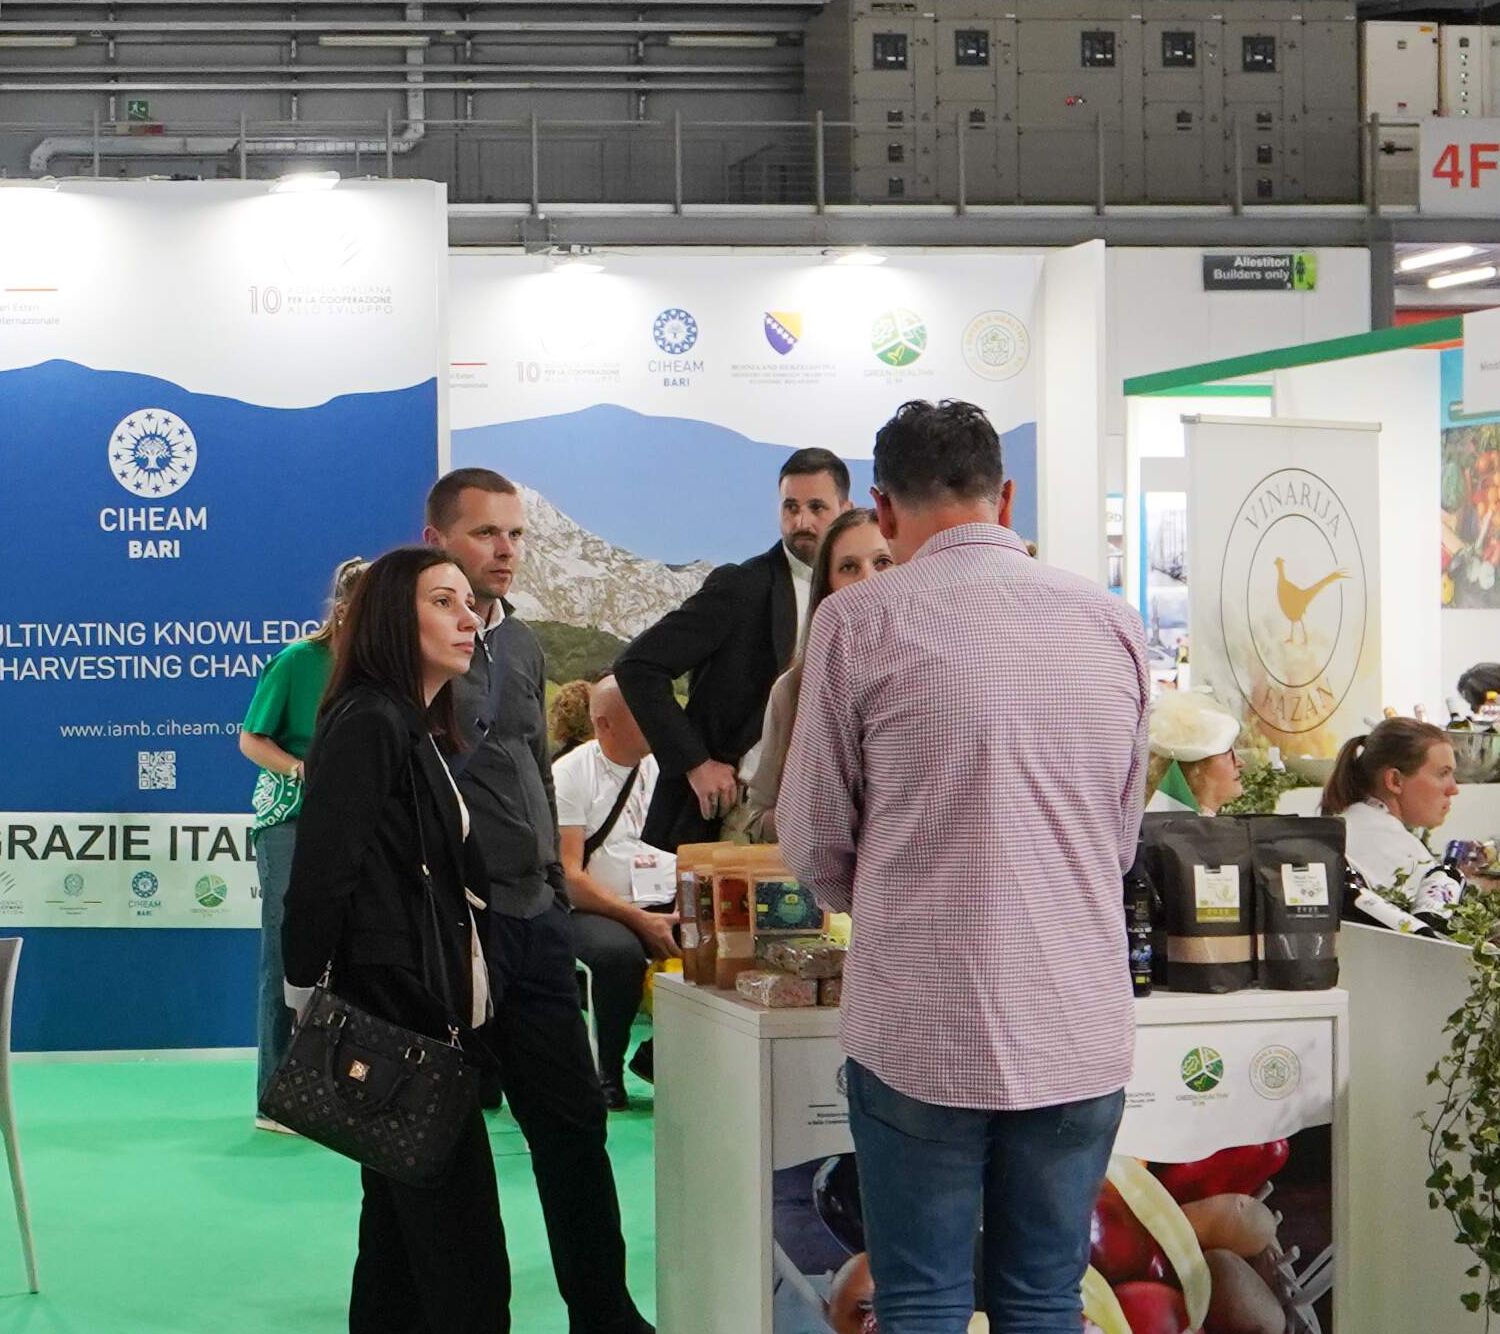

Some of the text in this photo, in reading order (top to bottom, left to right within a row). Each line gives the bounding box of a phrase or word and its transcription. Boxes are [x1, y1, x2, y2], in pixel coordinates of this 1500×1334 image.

[1233, 254, 1291, 268] Allestitori
[1213, 268, 1291, 283] Builders only
[248, 285, 283, 315] 10
[647, 360, 704, 373] CIHEAM
[663, 378, 690, 387] BARI
[99, 505, 208, 532] CIHEAM
[1244, 479, 1341, 541] VINARIJA
[128, 539, 181, 559] BARI
[153, 618, 328, 646] KNOWLEDG
[189, 652, 272, 679] CHAN
[59, 719, 244, 738] www.iamb.ciheam.or
[169, 824, 259, 862] ITAL
